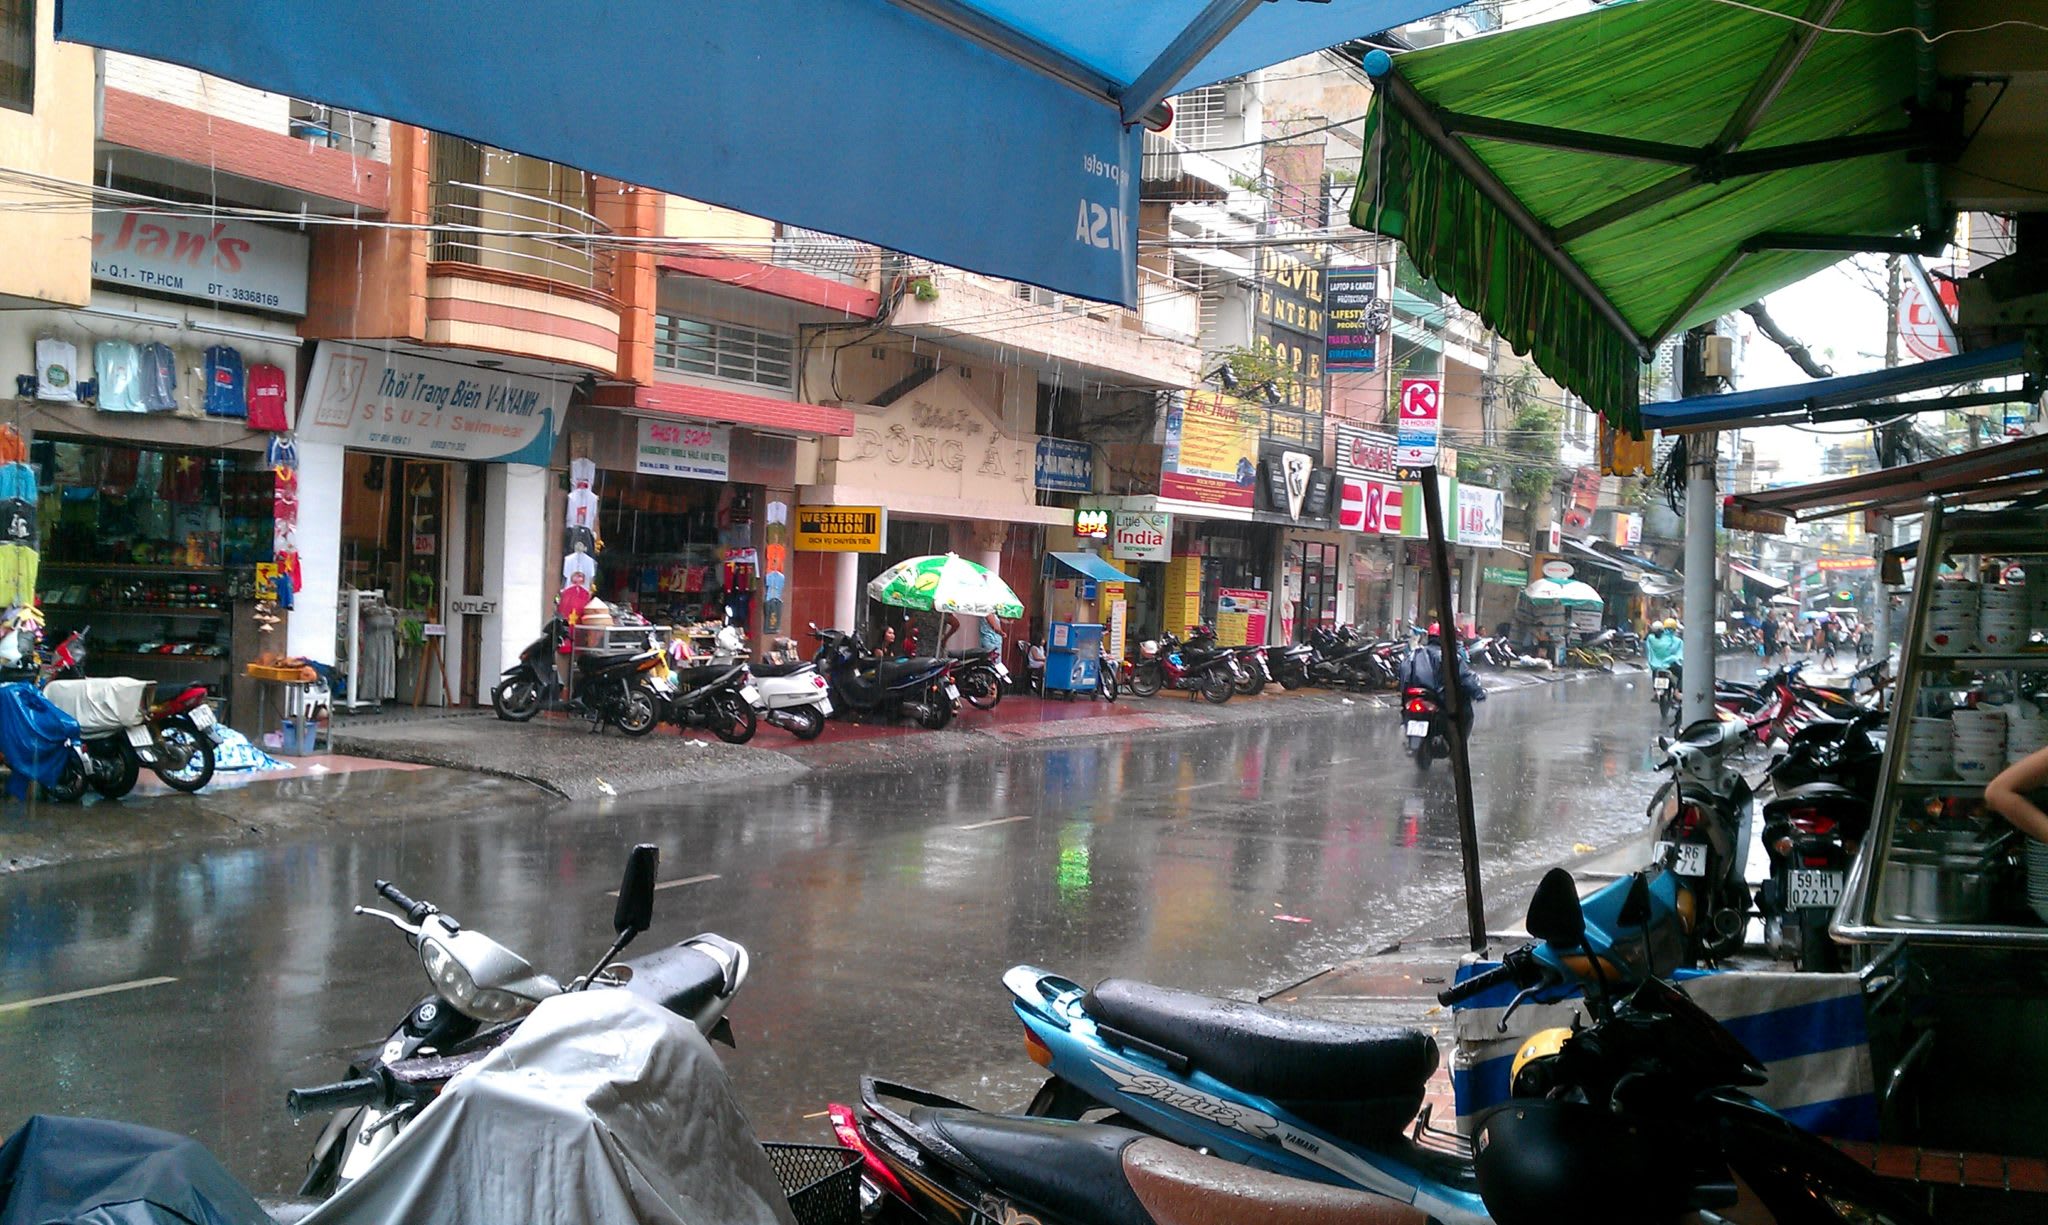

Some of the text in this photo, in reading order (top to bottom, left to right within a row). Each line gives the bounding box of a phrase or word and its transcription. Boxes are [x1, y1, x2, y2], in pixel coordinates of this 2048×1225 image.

[1262, 246, 1322, 304] DEVIL
[109, 264, 129, 279] Q.1
[139, 269, 184, 290] TP.HCM
[232, 286, 280, 307] 38368169
[452, 415, 528, 440] Swimwear
[801, 512, 864, 524] WESTERN
[1116, 515, 1141, 528] Little
[820, 522, 864, 534] UNION
[1077, 523, 1108, 534] SPA
[1117, 529, 1164, 546] India
[452, 601, 498, 616] OUTLET
[1792, 889, 1841, 906] 022.17
[1284, 1131, 1321, 1155] YAMAHA
